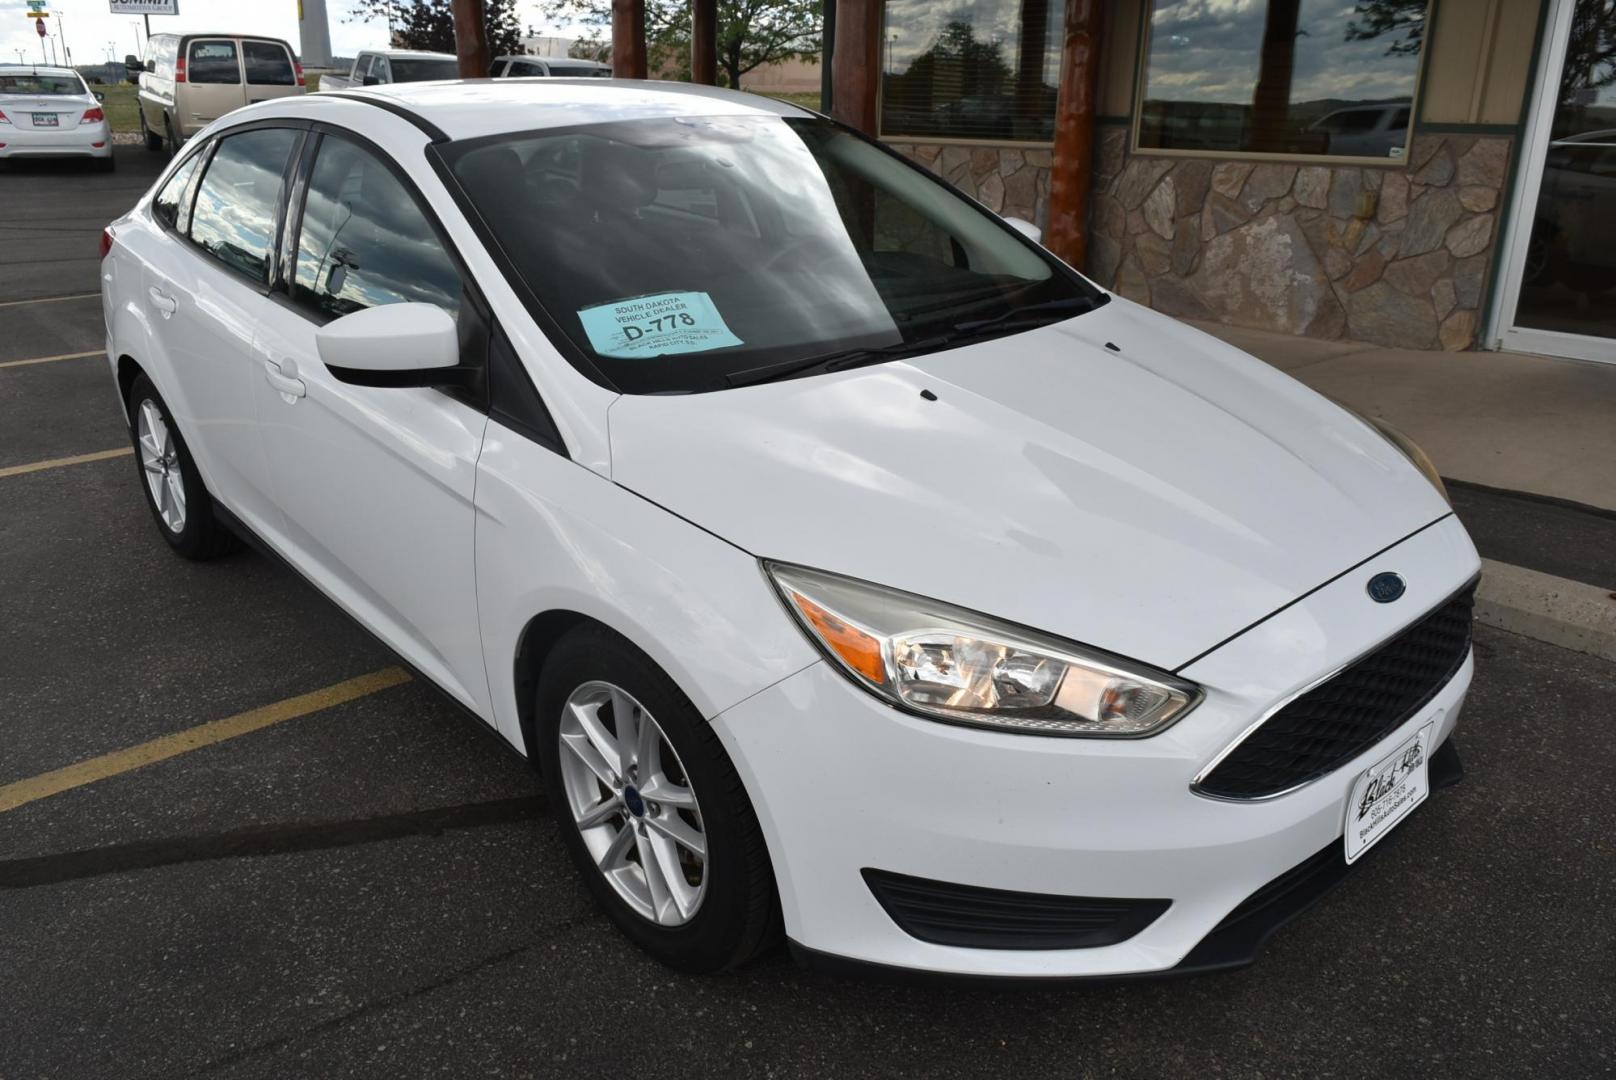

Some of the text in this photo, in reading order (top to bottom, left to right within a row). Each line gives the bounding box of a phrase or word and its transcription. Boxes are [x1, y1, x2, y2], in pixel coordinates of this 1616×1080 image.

[615, 297, 680, 315] SOUTH DAKOTA
[615, 303, 687, 324] VEHICLE DEALER
[622, 312, 696, 341] D-778
